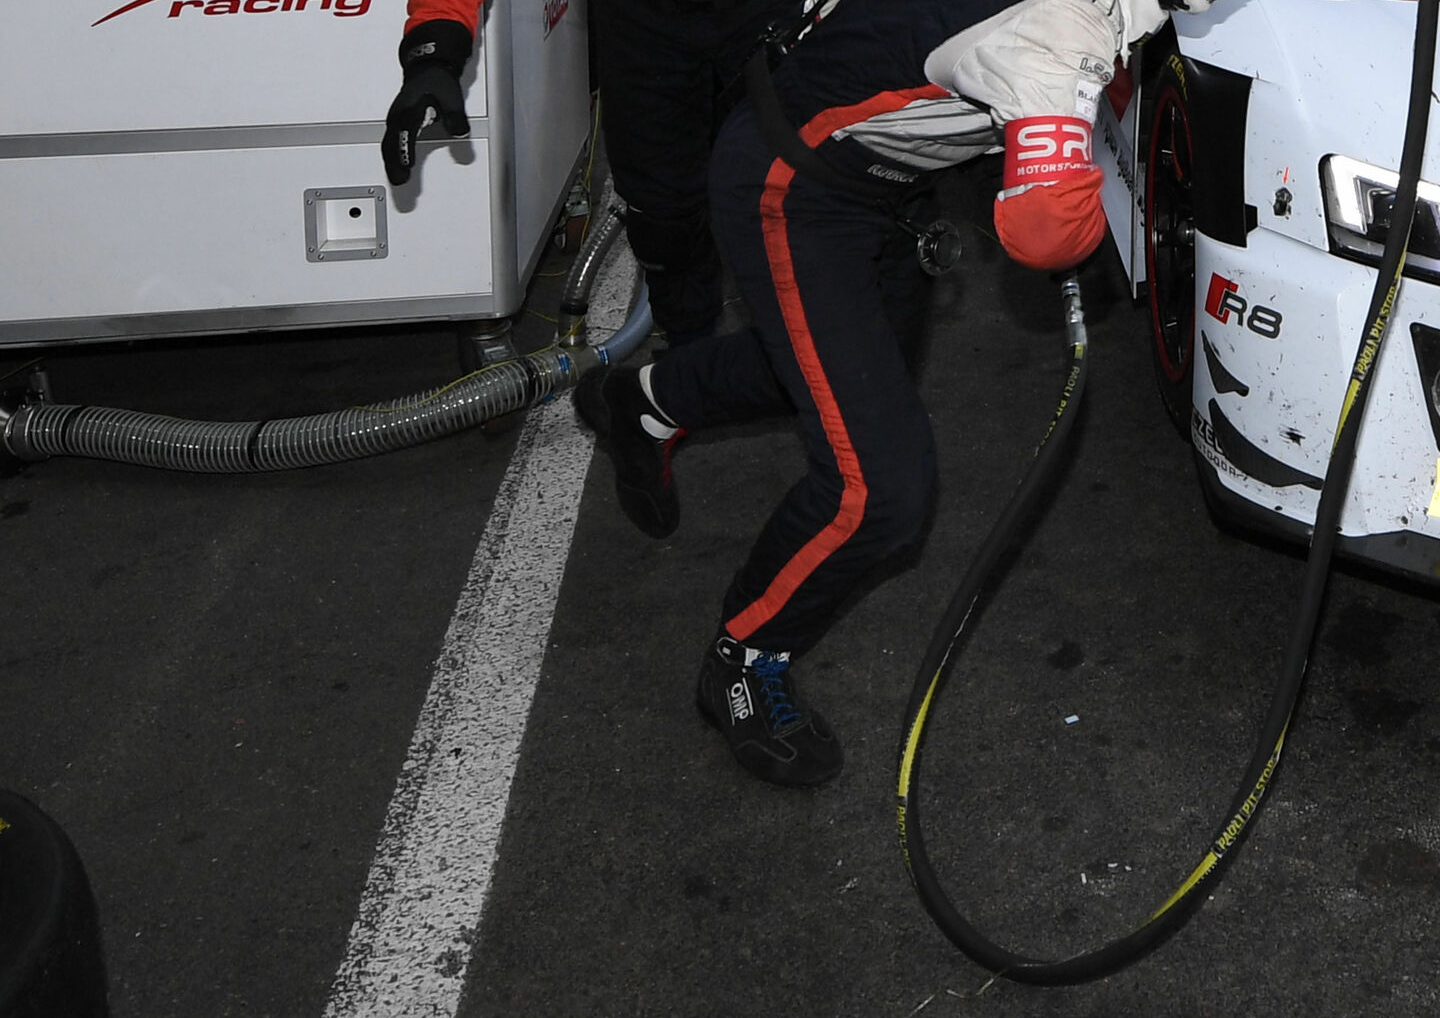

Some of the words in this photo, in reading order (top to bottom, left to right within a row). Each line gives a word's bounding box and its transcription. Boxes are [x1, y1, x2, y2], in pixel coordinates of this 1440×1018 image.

[1017, 123, 1093, 161] SR
[1218, 290, 1283, 340] R8
[1356, 339, 1378, 375] PAOLI
[1371, 318, 1386, 338] PIT
[1380, 285, 1397, 316] STOP
[1064, 365, 1081, 397] PAOLI
[730, 682, 749, 720] OMP
[1218, 813, 1246, 850] PAOLI
[1241, 793, 1257, 815] PIT
[1255, 759, 1275, 790] STOP
